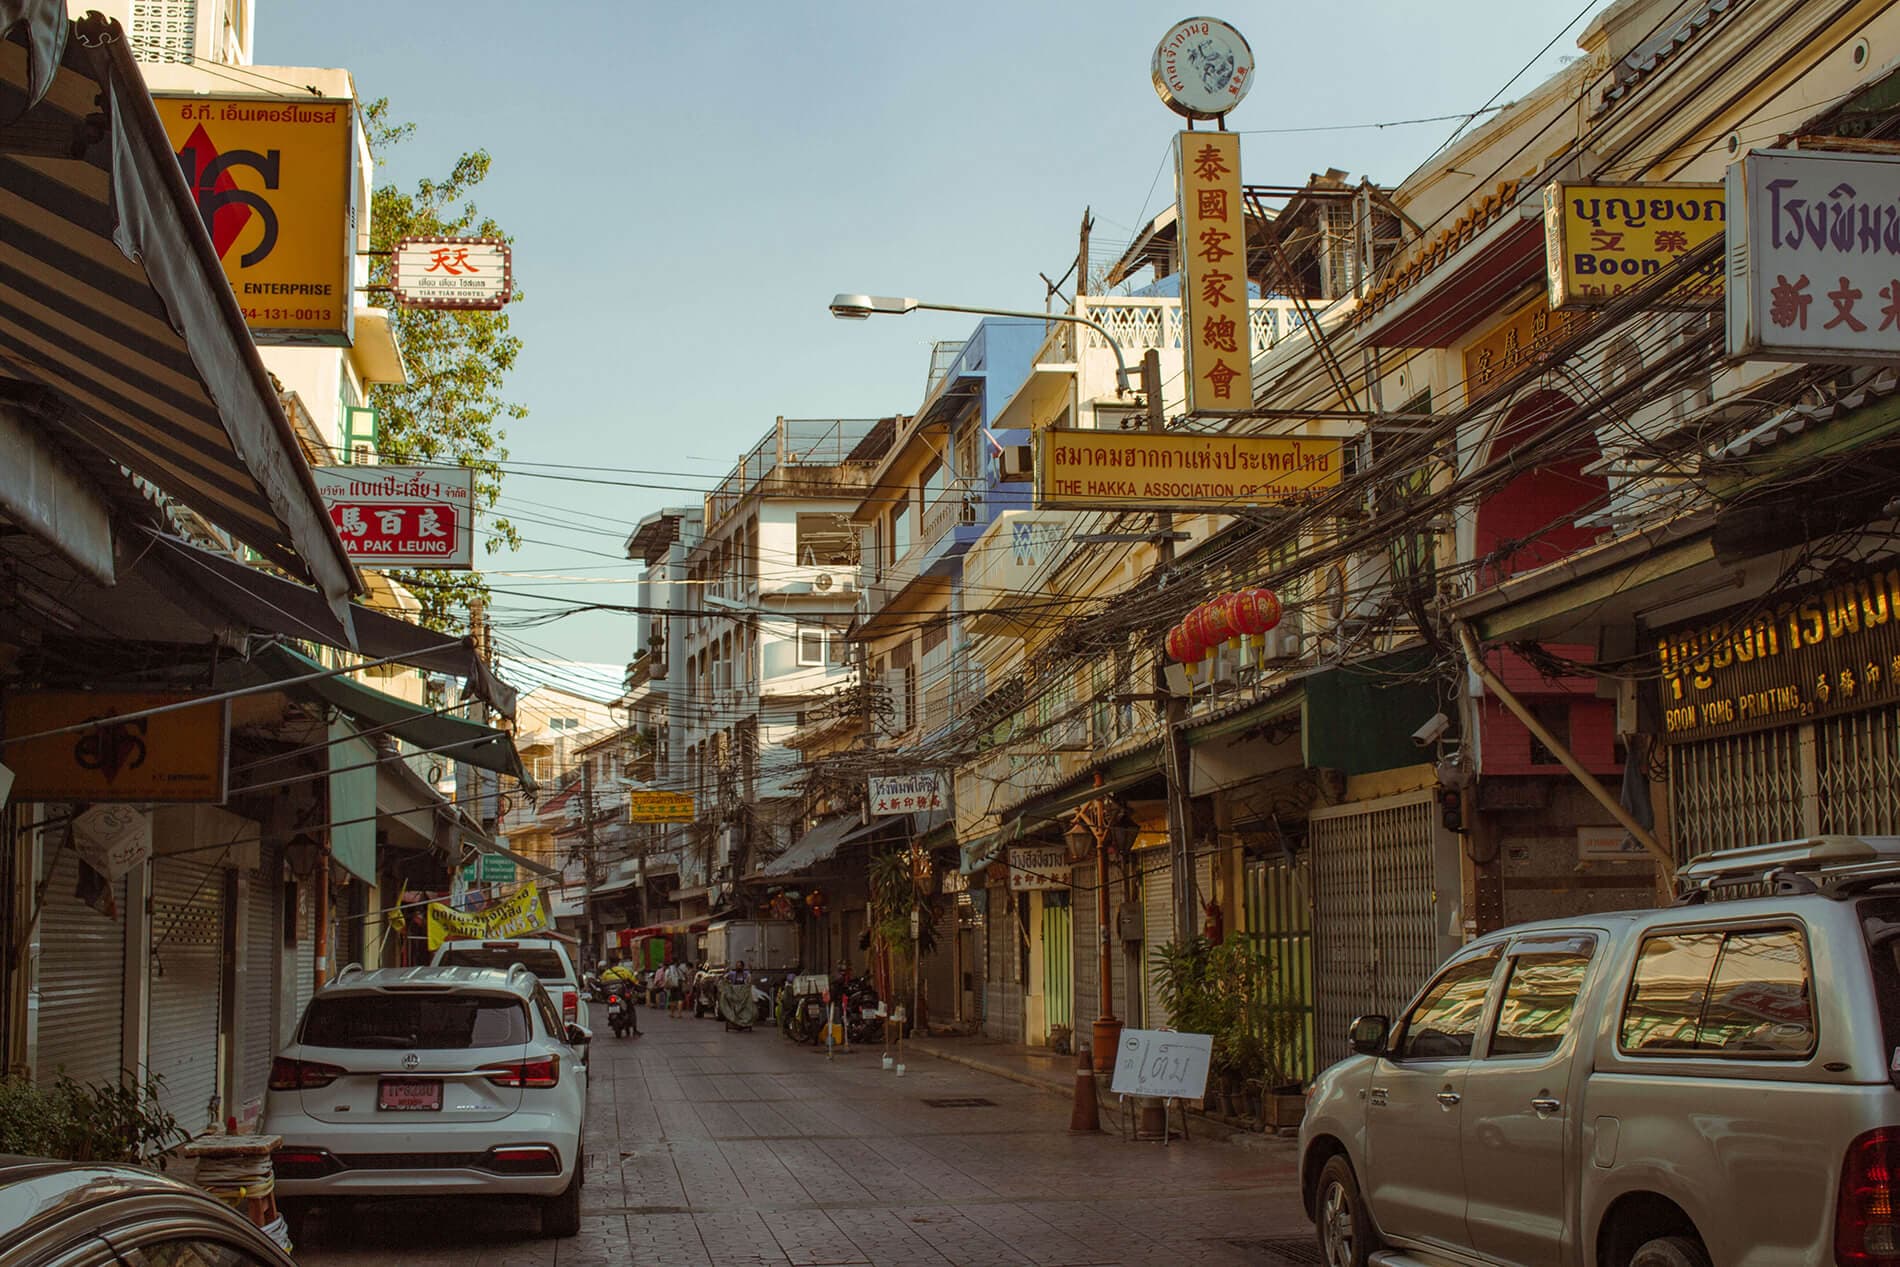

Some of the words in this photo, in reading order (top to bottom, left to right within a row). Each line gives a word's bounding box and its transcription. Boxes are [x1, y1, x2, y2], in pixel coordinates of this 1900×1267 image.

[423, 247, 481, 276] 天天
[1193, 143, 1242, 400] 泰國客家總會
[1574, 254, 1661, 275] Boon
[244, 283, 332, 295] ENTERPRISE
[1579, 284, 1606, 298] Tel
[1055, 441, 1329, 472] สมาคมฮากกาแห่งประเทศไทย
[320, 484, 345, 497] บริษัท
[445, 486, 467, 499] จำกัด
[1056, 479, 1083, 496] THE
[1087, 481, 1137, 497] HAKKA
[1143, 482, 1234, 498] ASSOCIATION
[1239, 484, 1258, 498] OF
[336, 507, 448, 538] 馬百良
[363, 540, 393, 552] PAK
[398, 541, 447, 553] LEUNG
[1666, 703, 1697, 733] BOON
[1701, 694, 1734, 726] YONG
[1738, 684, 1800, 721] PRINTING
